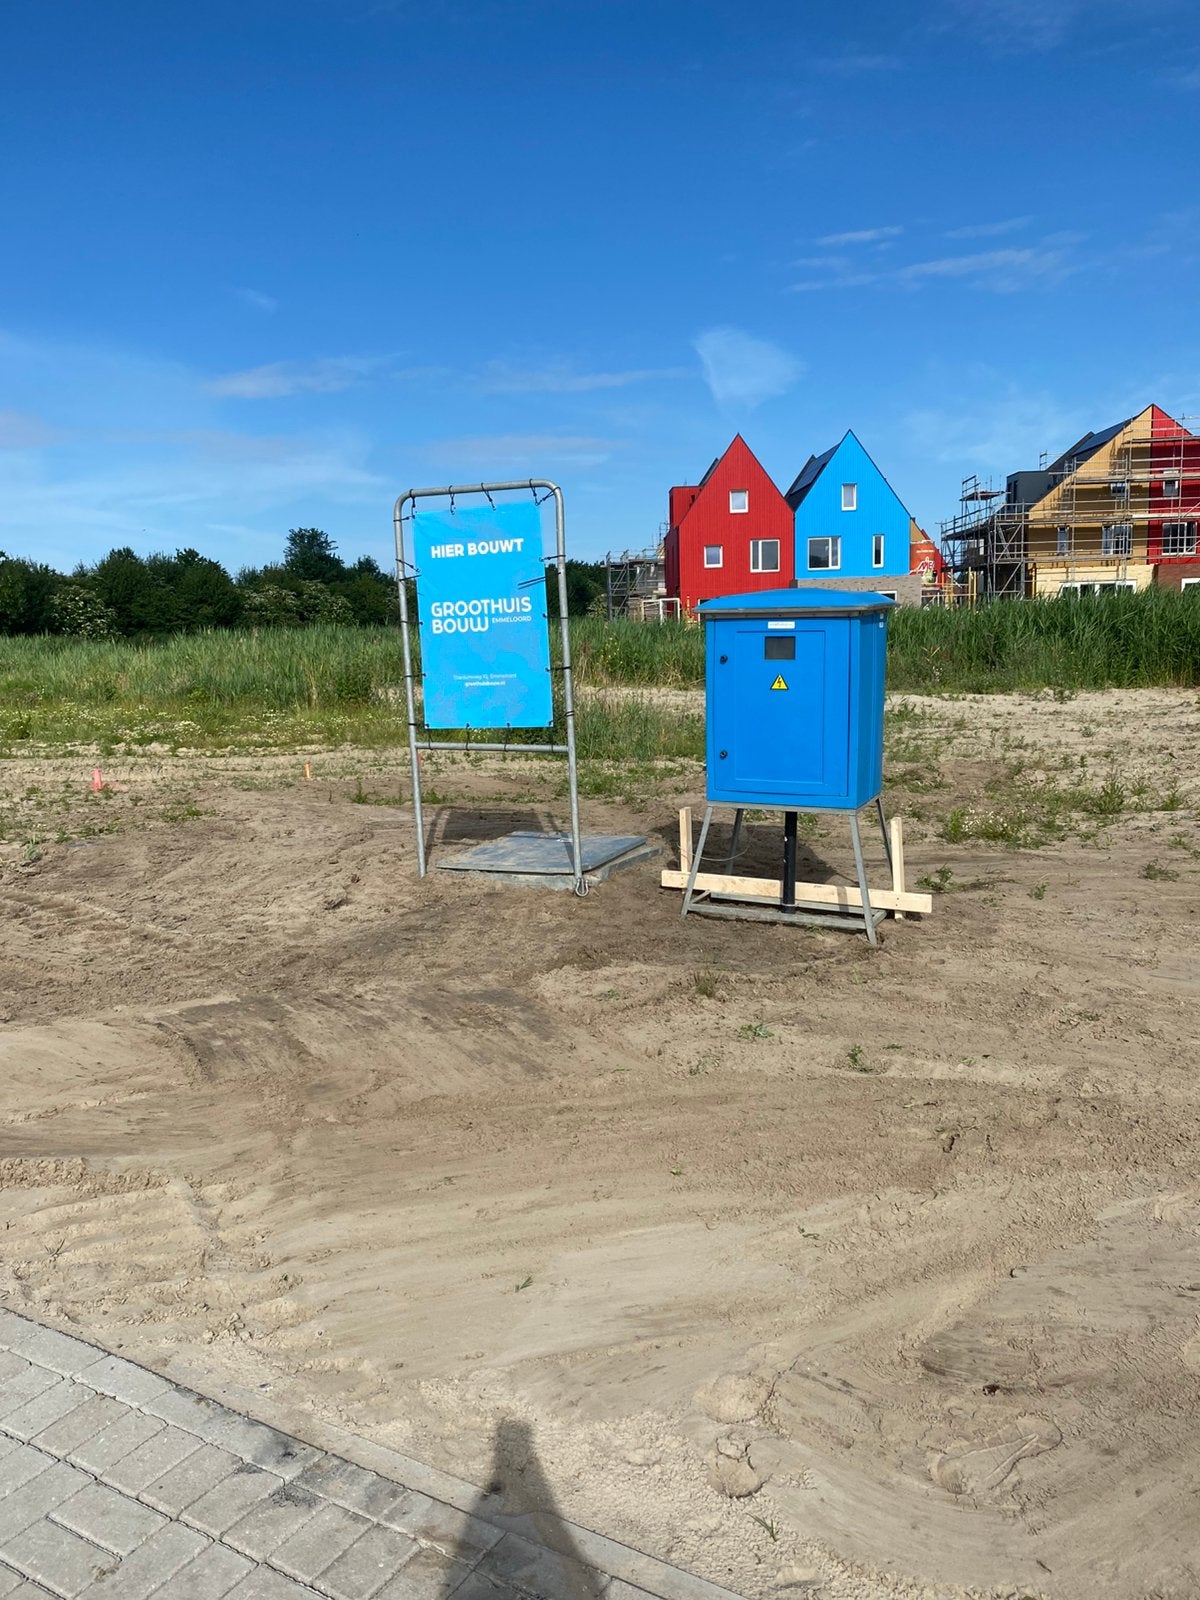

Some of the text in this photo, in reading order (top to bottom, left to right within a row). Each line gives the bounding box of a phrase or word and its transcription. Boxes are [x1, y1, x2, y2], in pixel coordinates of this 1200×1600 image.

[431, 538, 524, 558] HIER BOUWT
[431, 597, 532, 617] GROOTHUIS
[432, 615, 532, 634] BOUW EMMELOORD
